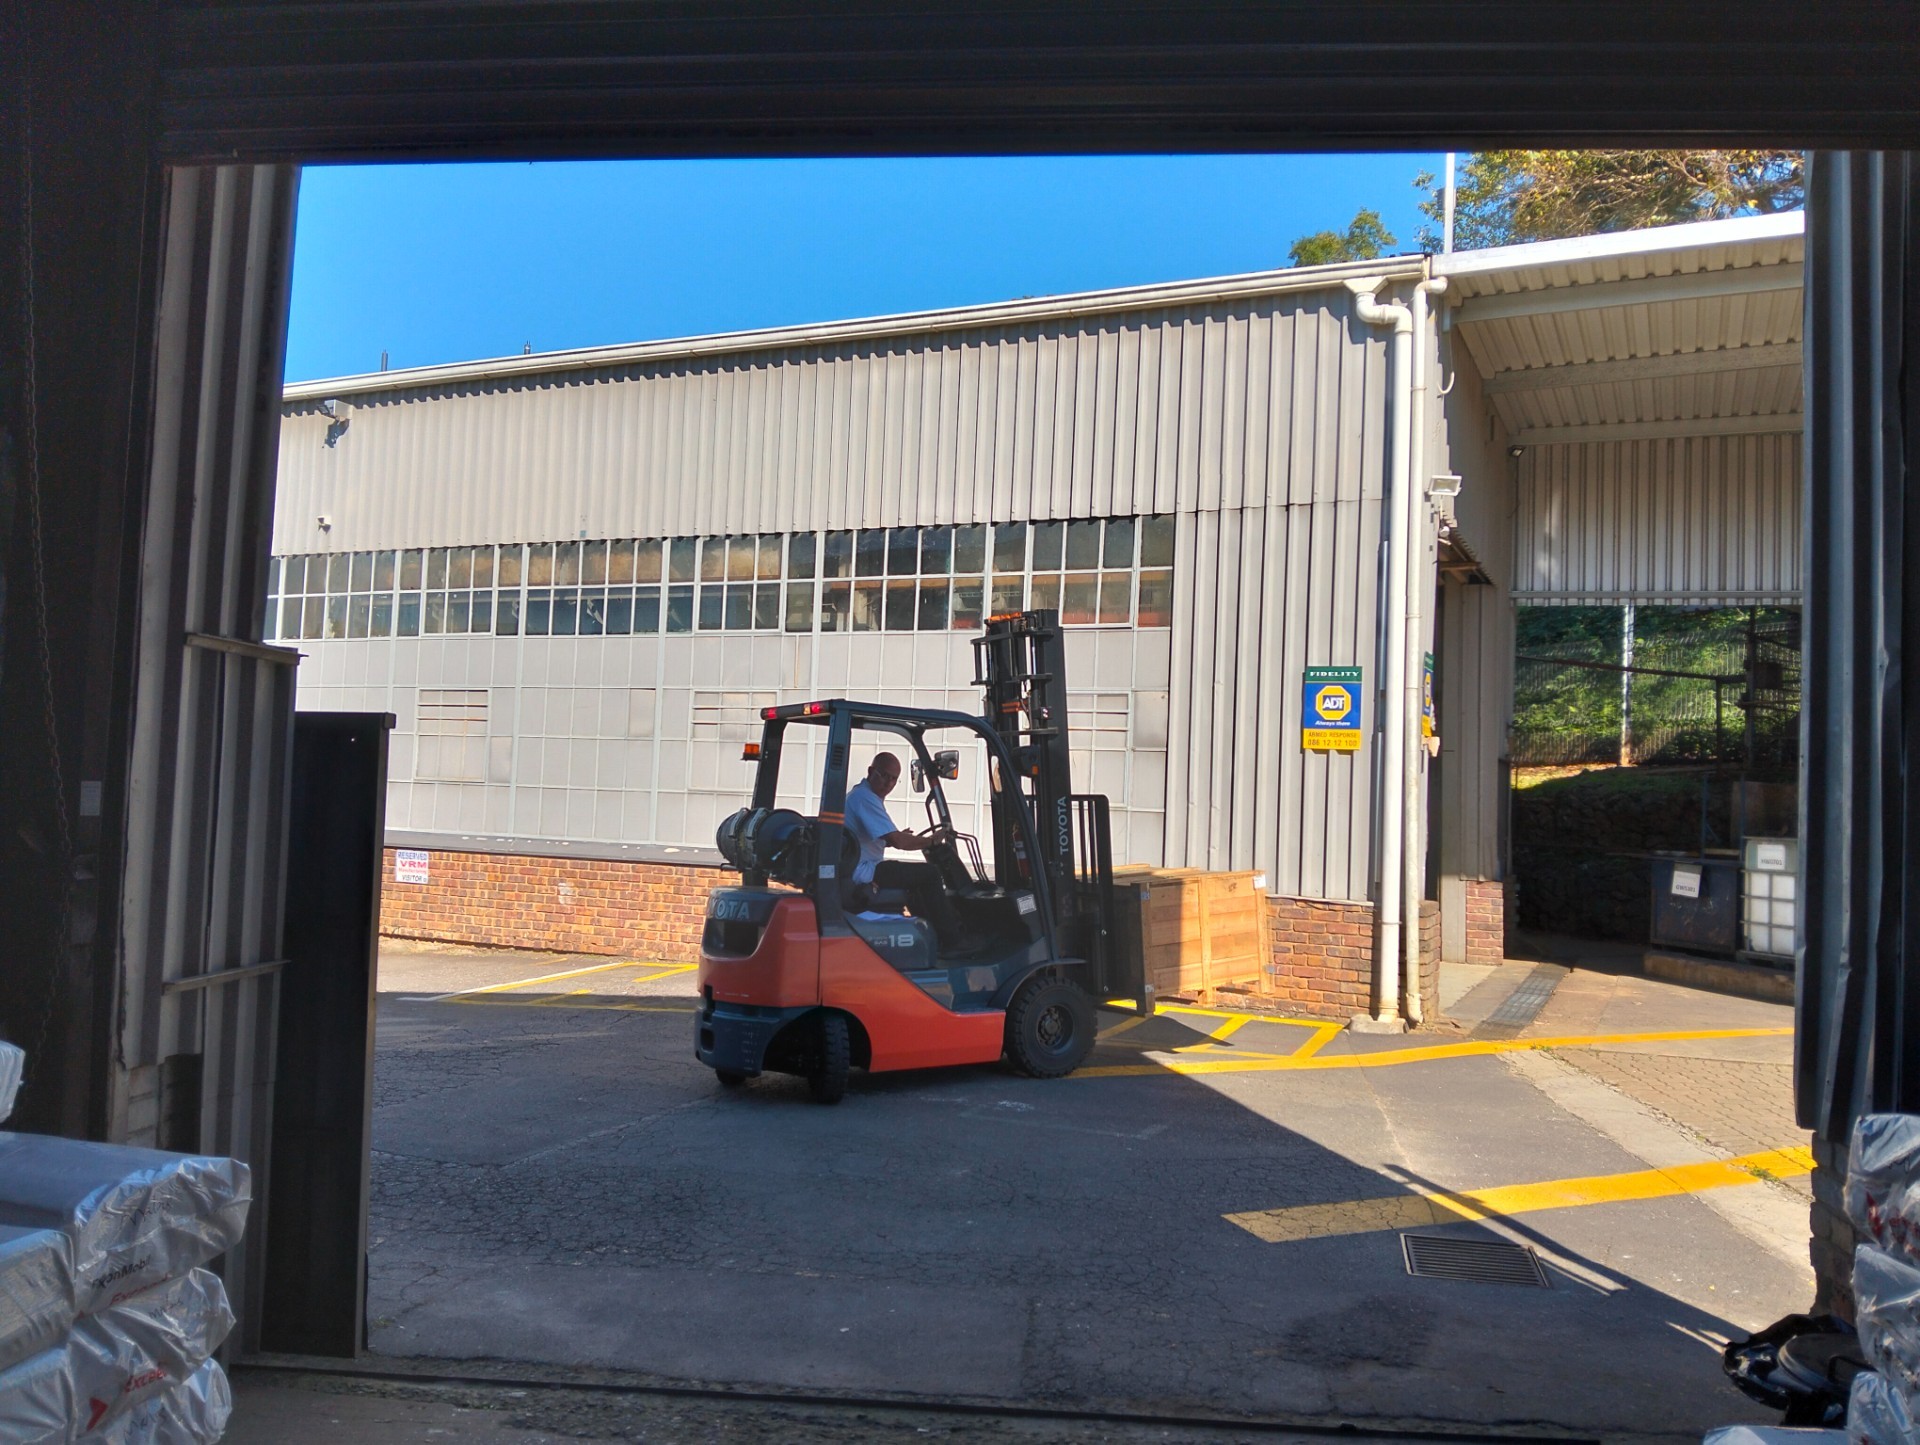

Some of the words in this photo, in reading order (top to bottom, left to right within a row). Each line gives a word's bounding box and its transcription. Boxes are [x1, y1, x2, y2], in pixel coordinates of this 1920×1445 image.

[1322, 696, 1345, 710] ADT
[1345, 739, 1358, 747] 100
[1057, 796, 1069, 856] TOYOTA
[397, 851, 427, 861] RESERVED
[400, 860, 427, 868] VRM
[888, 934, 914, 947] 18
